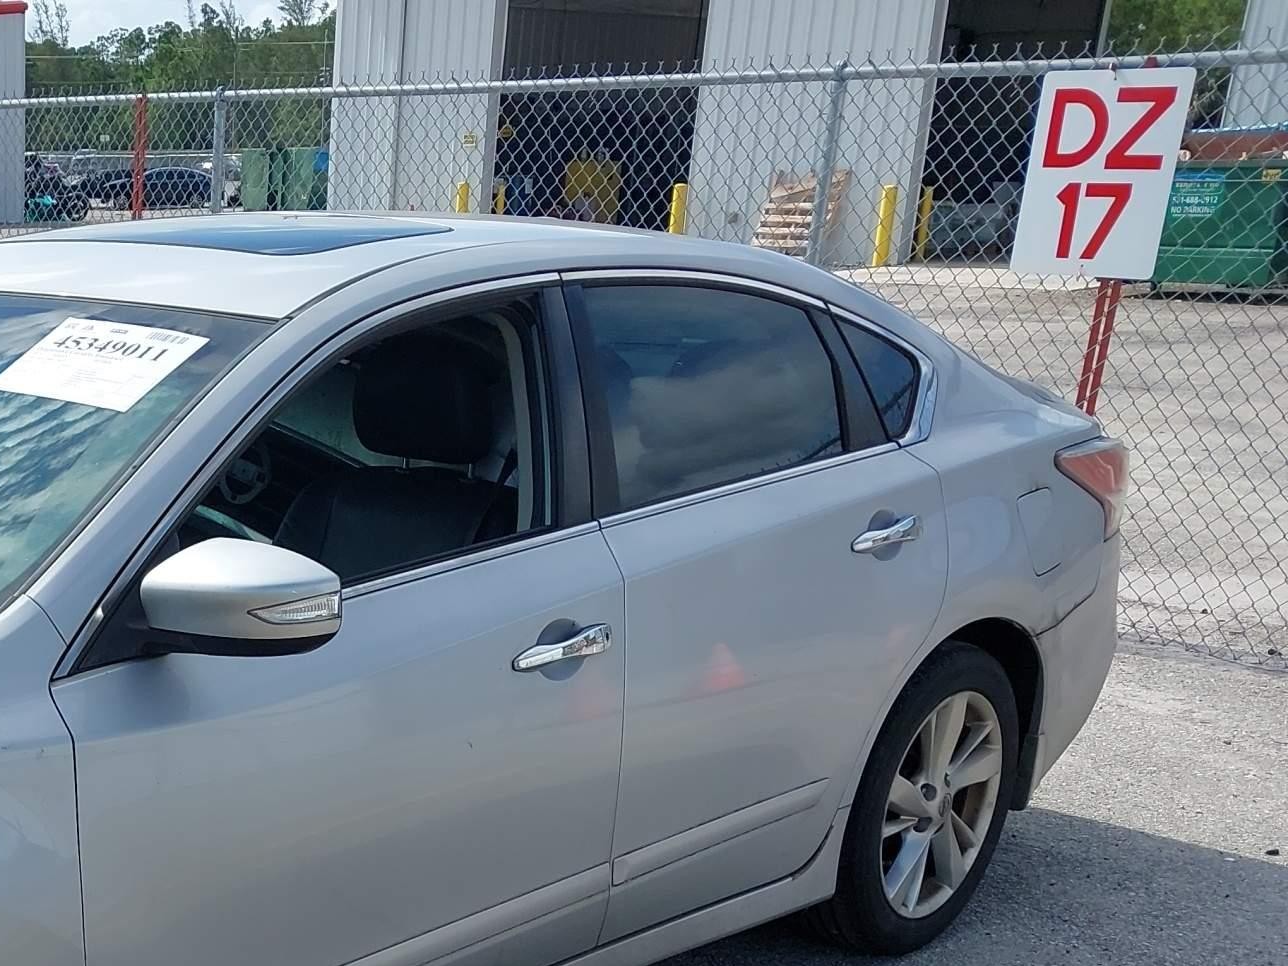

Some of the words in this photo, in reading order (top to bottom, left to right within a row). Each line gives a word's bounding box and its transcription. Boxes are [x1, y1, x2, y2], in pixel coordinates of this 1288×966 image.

[1042, 86, 1177, 171] DZ
[1055, 182, 1132, 261] 17
[53, 335, 169, 362] 45349011
